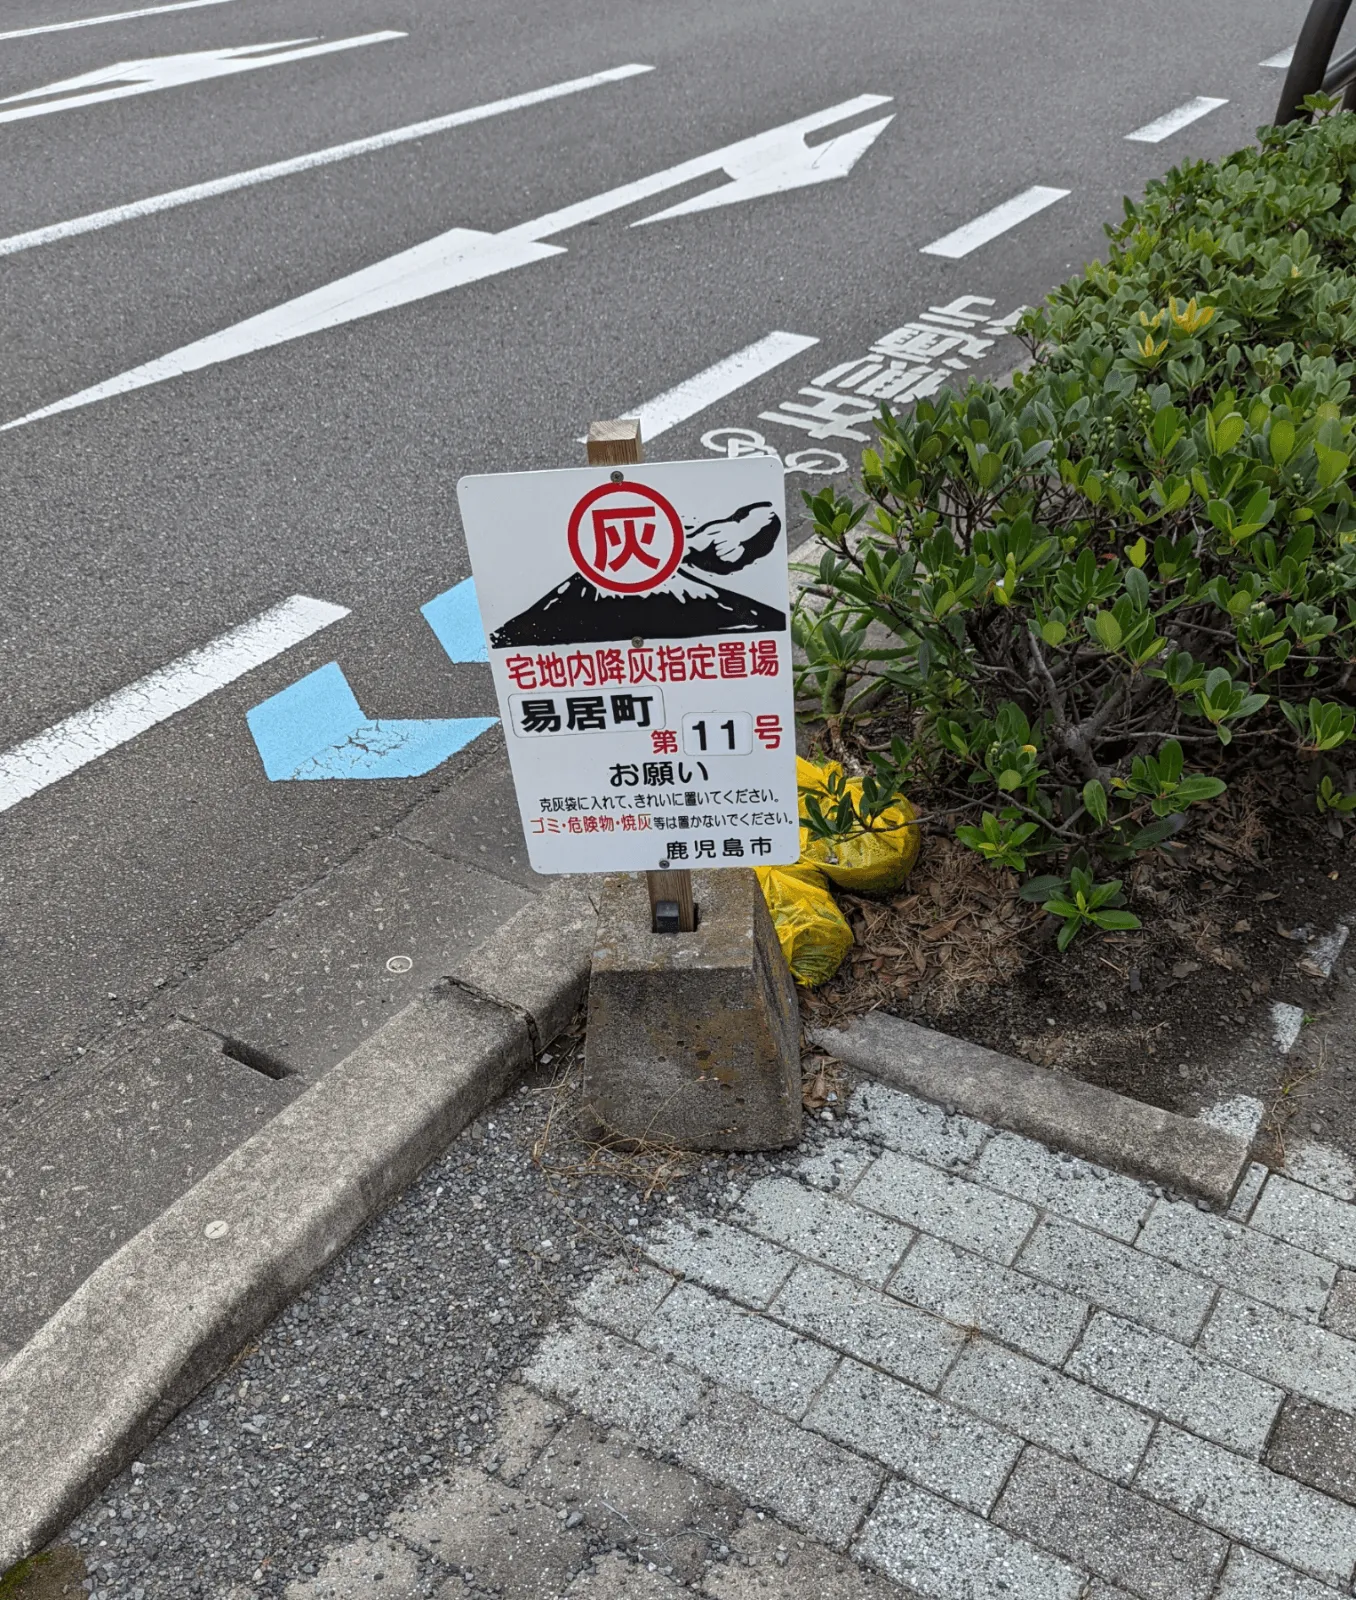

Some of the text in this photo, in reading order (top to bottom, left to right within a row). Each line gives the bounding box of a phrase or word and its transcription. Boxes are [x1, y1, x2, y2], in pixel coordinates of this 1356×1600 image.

[592, 506, 661, 573] 灰
[505, 639, 780, 690] 宅地内降灰指定置場
[520, 693, 654, 733] 易居町
[608, 761, 709, 787] お願い
[538, 789, 780, 813] 克灰袋に入れて、きれいに置いてください。
[666, 836, 773, 860] 鹿児島市
